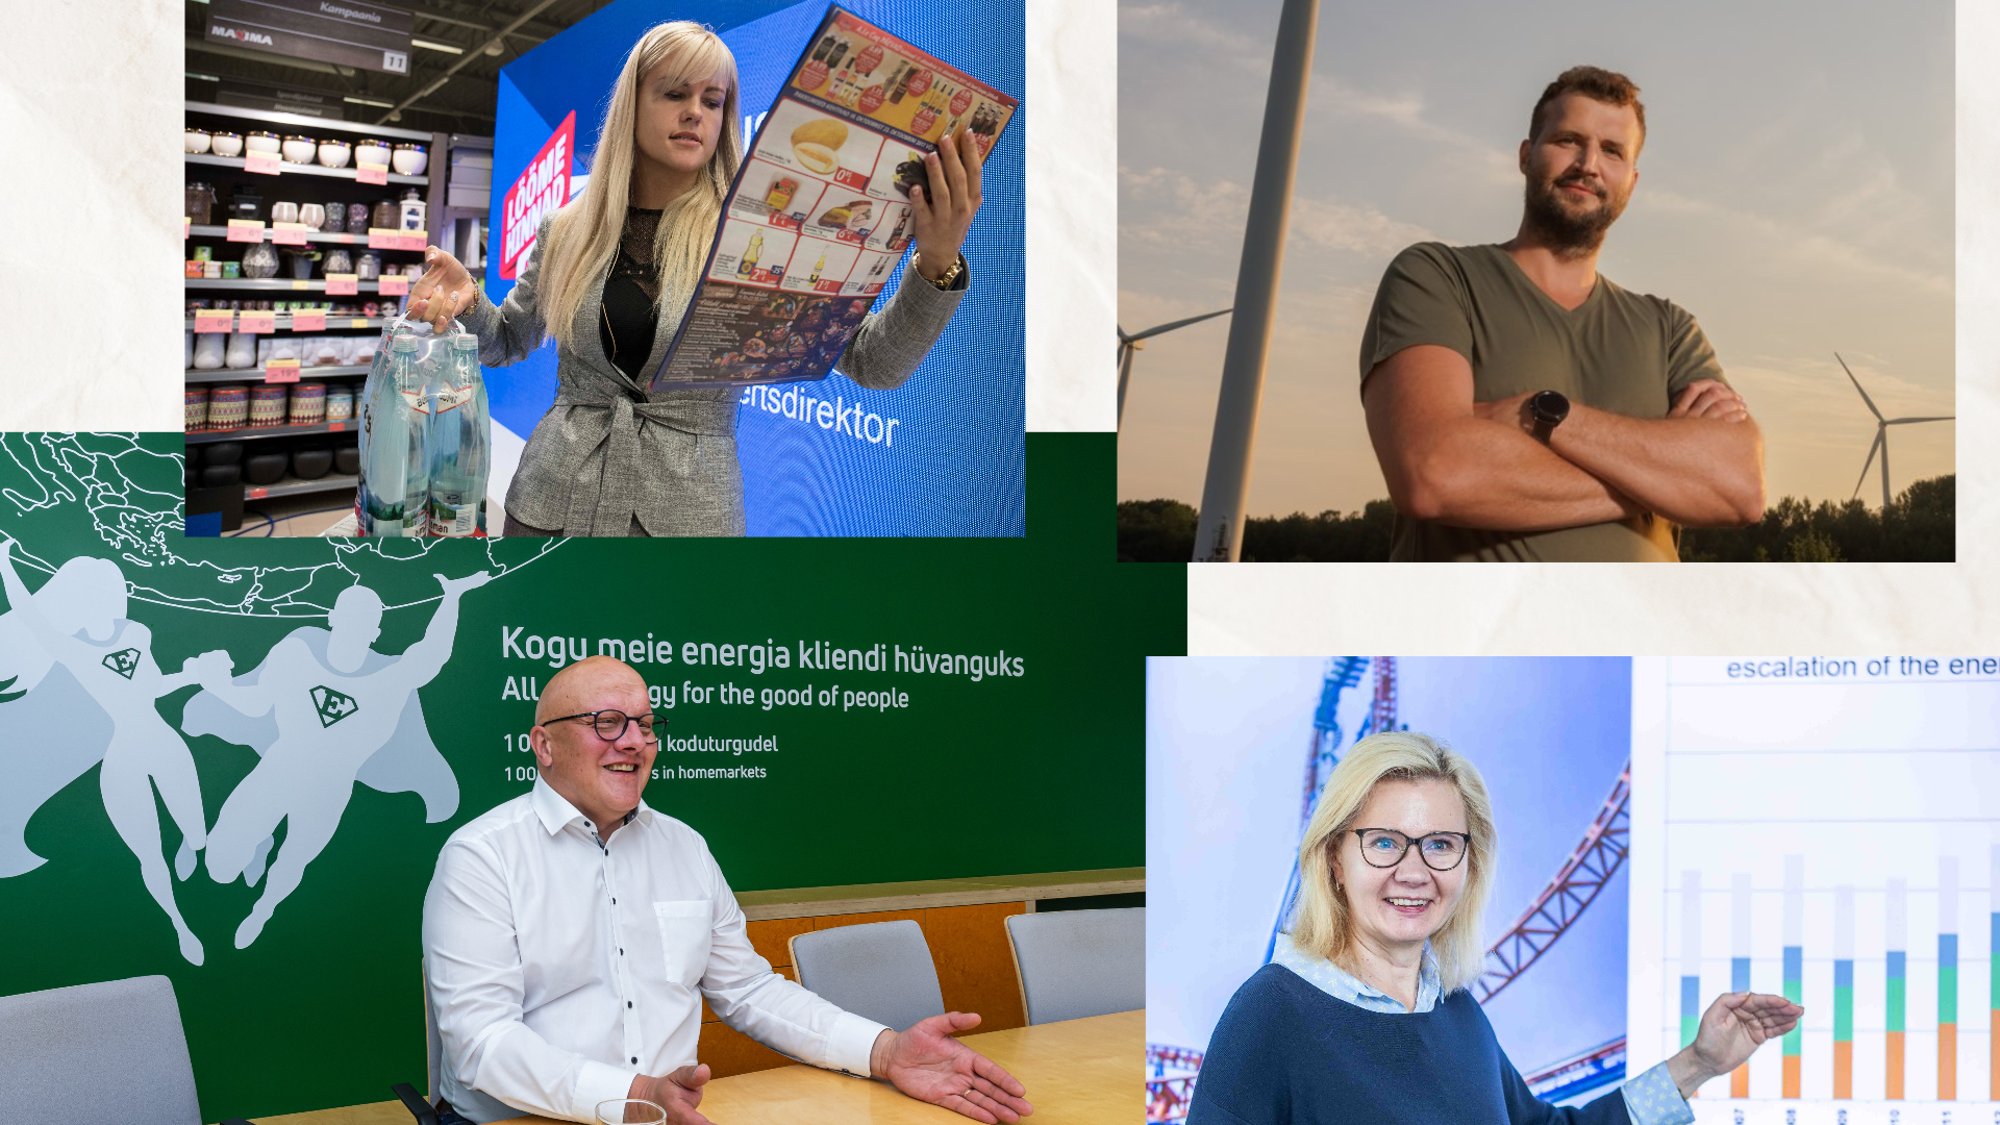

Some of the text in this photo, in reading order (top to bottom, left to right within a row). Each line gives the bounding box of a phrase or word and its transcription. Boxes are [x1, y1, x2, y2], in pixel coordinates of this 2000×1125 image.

[320, 2, 381, 23] Kampaania
[211, 25, 273, 46] MAXIMA
[388, 56, 403, 68] 11
[507, 133, 567, 231] LÖÖME
[505, 174, 566, 264] HINNAD
[740, 385, 900, 447] ertsdirektor
[502, 626, 1025, 682] Kogu meie energia kliendi hüvanguks
[1727, 656, 2000, 678] escalation of the ene
[501, 676, 540, 701] All
[683, 681, 714, 704] for
[720, 682, 755, 705] the
[760, 684, 812, 711] good
[818, 685, 839, 706] of
[843, 687, 909, 713] people
[667, 735, 779, 756] koduturgudel
[663, 766, 675, 780] in
[678, 765, 767, 780] homemarkets
